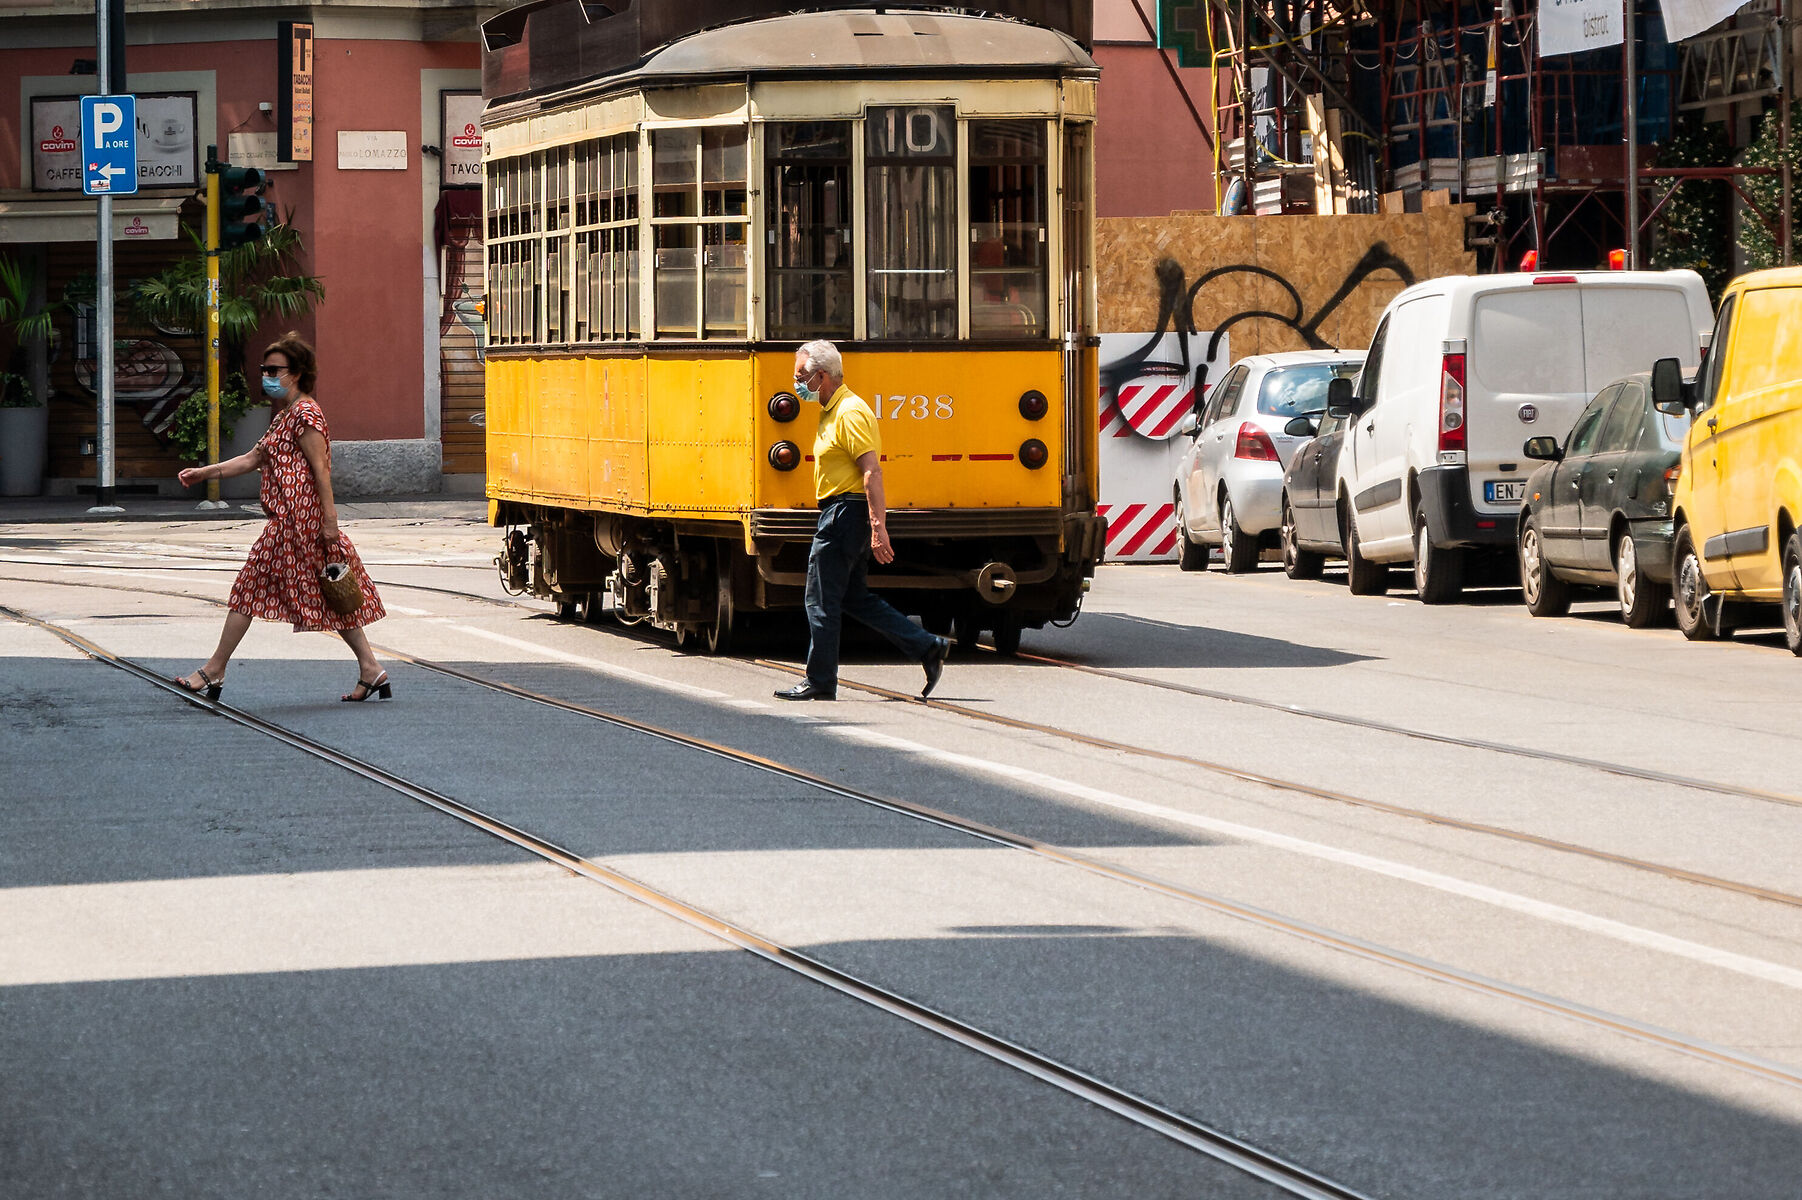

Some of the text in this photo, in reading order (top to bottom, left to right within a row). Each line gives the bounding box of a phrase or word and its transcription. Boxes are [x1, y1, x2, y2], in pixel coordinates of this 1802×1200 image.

[1583, 9, 1609, 38] bistrot
[294, 27, 312, 72] T
[93, 103, 123, 149] P
[886, 108, 937, 153] 10
[42, 140, 75, 150] covim
[105, 140, 129, 149] A ORE
[359, 149, 407, 158] LOMAZZO
[874, 394, 954, 420] 1738
[1496, 484, 1514, 499] EN
